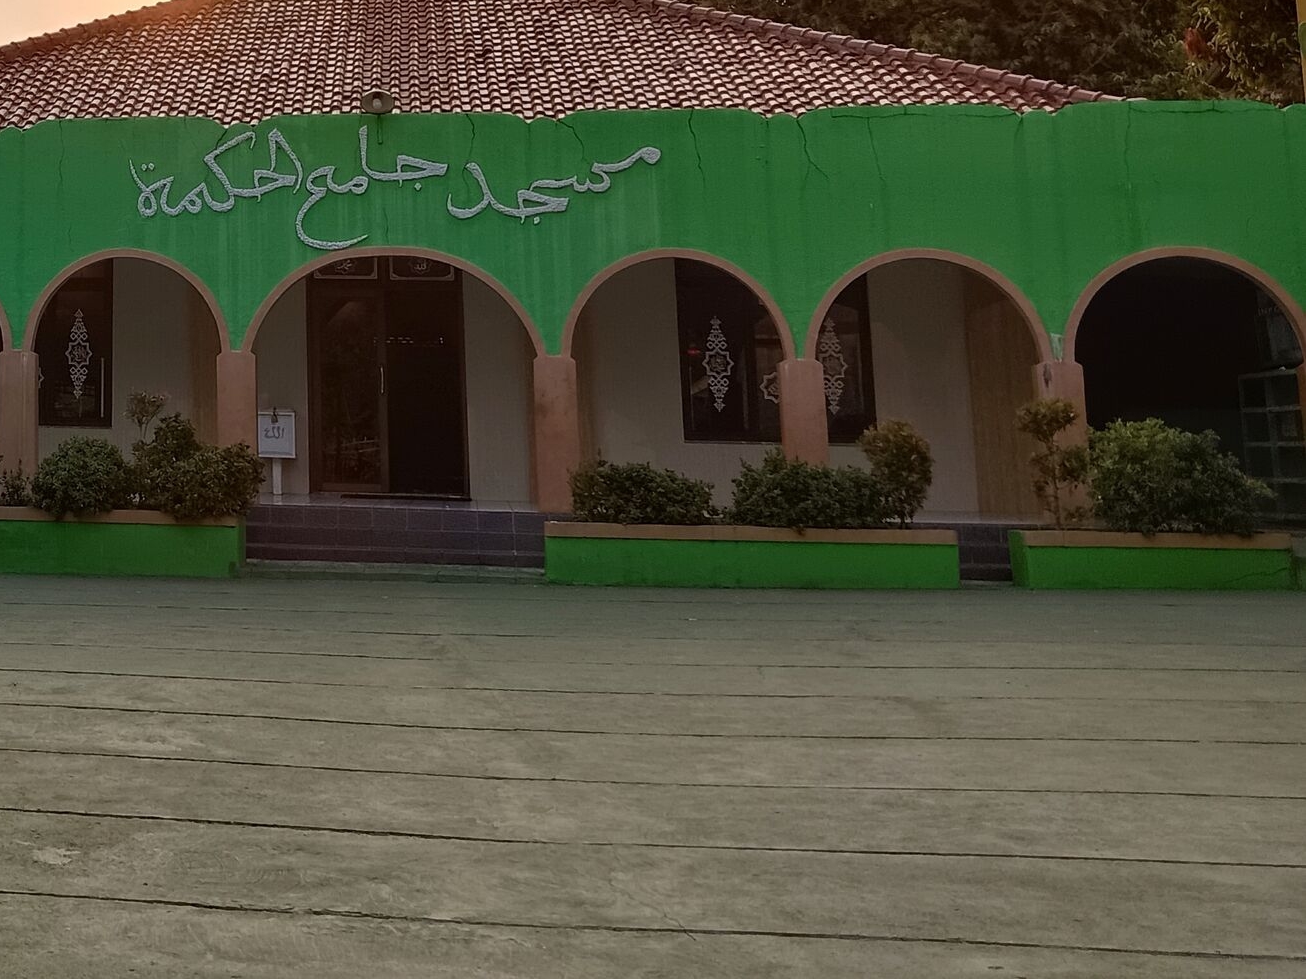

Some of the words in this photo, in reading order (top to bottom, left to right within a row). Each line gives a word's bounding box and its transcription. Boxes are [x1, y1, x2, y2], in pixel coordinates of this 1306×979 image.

[129, 130, 302, 219] الحكمة
[295, 125, 448, 251] جامع
[446, 146, 662, 226] مسجد
